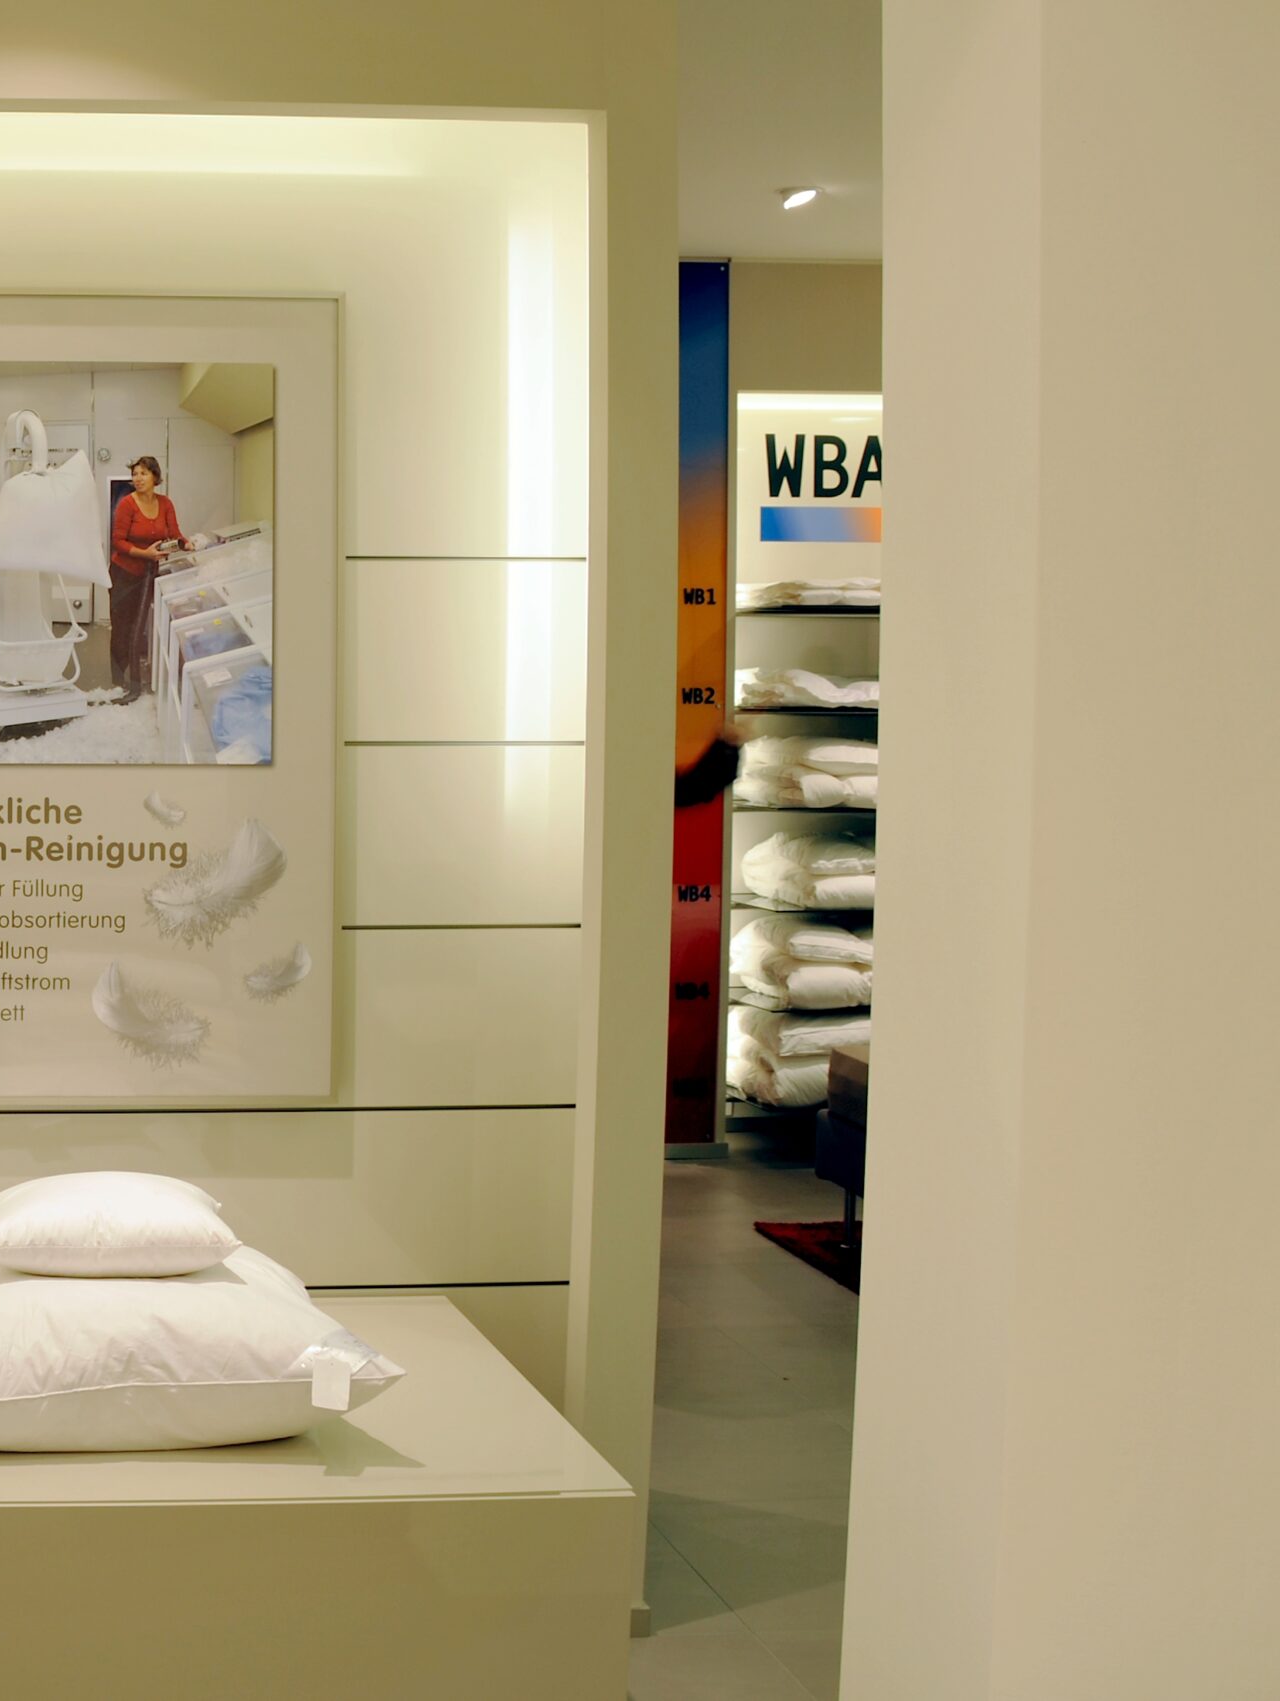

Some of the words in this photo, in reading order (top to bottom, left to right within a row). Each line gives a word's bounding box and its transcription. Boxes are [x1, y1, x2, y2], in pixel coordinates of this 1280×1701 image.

[684, 588, 716, 605] WB1
[682, 687, 715, 704] WB2
[13, 879, 83, 902] Füllung
[678, 885, 711, 902] WB4
